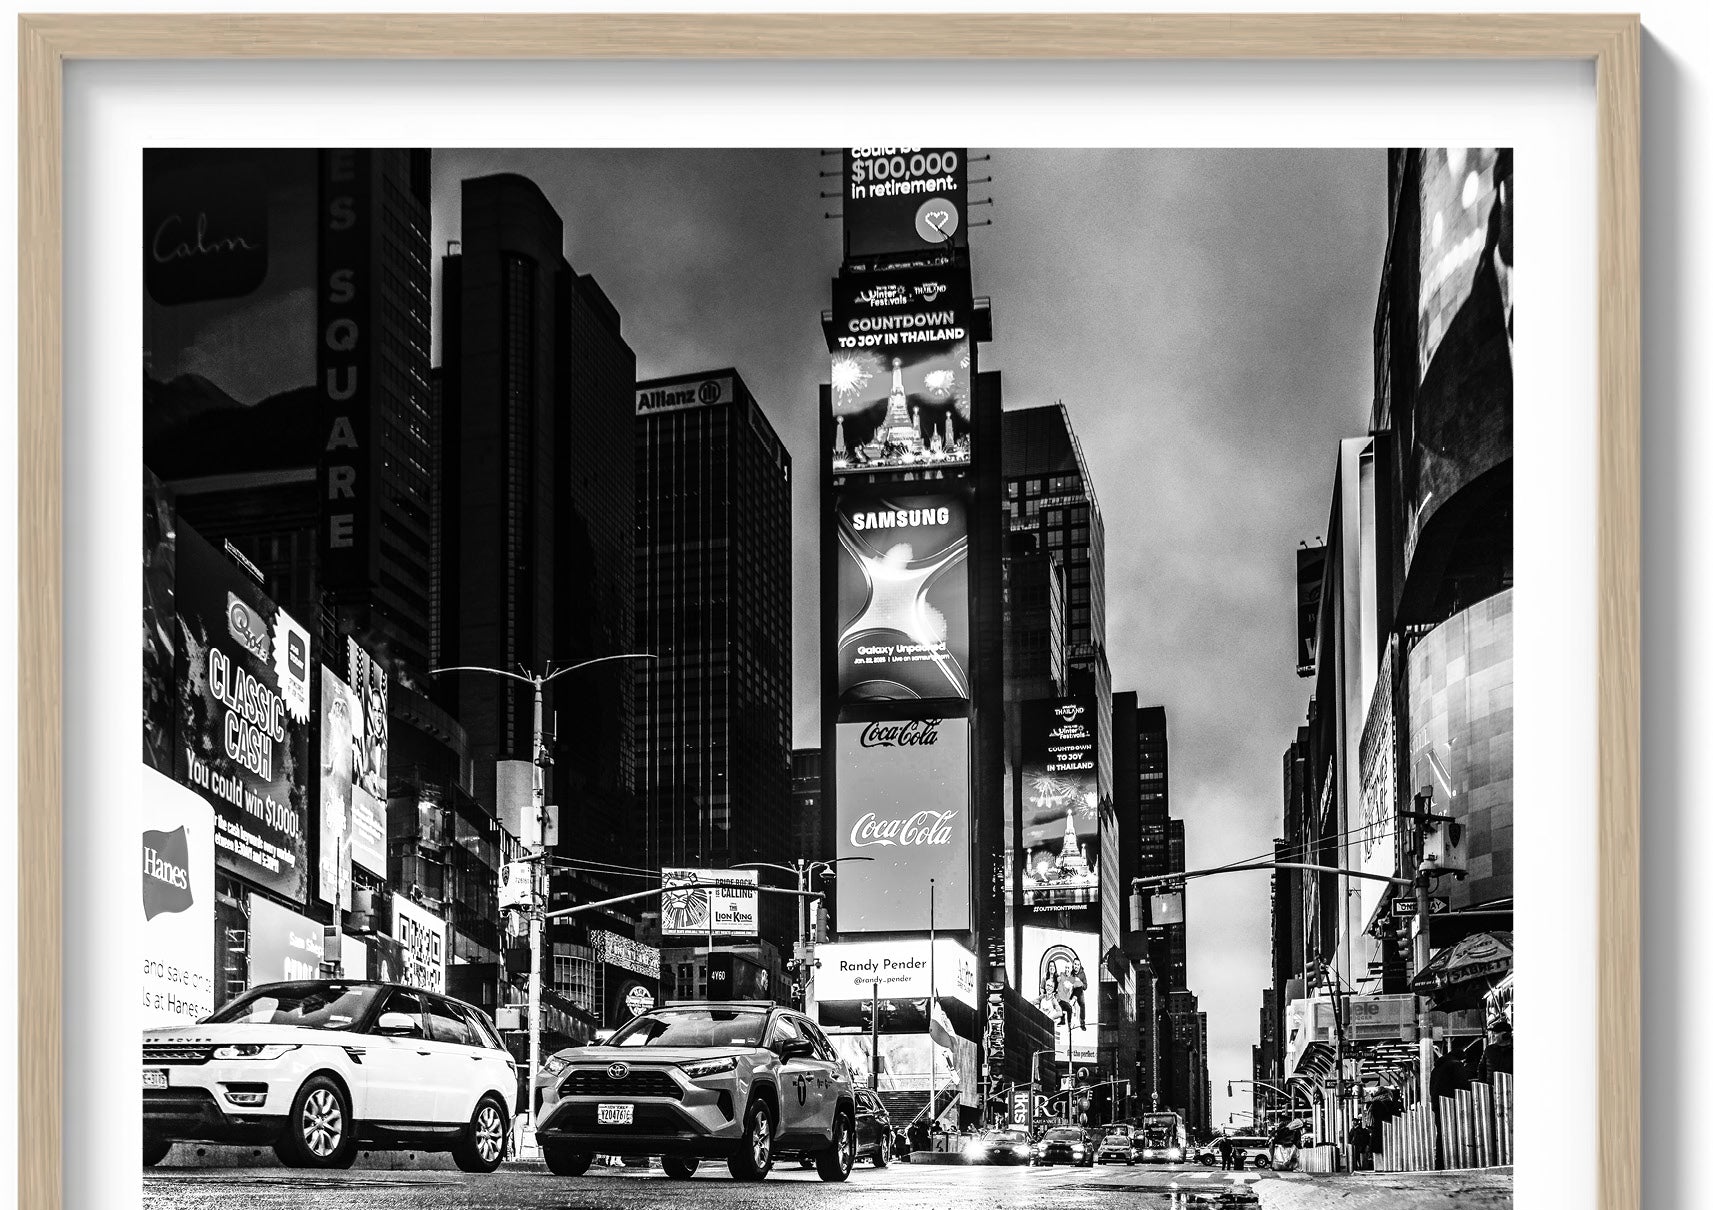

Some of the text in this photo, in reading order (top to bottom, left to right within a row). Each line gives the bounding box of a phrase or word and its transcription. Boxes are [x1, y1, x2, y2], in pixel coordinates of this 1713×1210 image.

[851, 151, 958, 184] $100,000
[852, 175, 957, 199] in retirement.
[848, 310, 955, 333] COUNTDOWN
[838, 328, 966, 348] TO JOY IN THAILAND
[325, 269, 359, 549] SQUARE
[638, 389, 696, 411] Allianz
[852, 507, 950, 531] SAMSUNG
[857, 645, 895, 657] Galaxy
[209, 647, 285, 743] CLASSIC
[225, 709, 273, 783] CASH
[1047, 744, 1092, 753] COUNTDOWN
[1057, 752, 1084, 762] TO JOY
[1046, 762, 1095, 772] IN THAILAND
[186, 748, 209, 790] You
[211, 776, 243, 808] could
[245, 789, 264, 820] win
[850, 810, 959, 848] Coca-Cola
[143, 846, 188, 890] Hanes
[721, 887, 753, 899] CALLING
[143, 959, 164, 978] and
[167, 966, 189, 986] save
[840, 957, 927, 973] Randy Pender
[853, 975, 912, 986] @randy_pender
[167, 992, 199, 1018] Hanes
[1014, 1092, 1030, 1124] tkts
